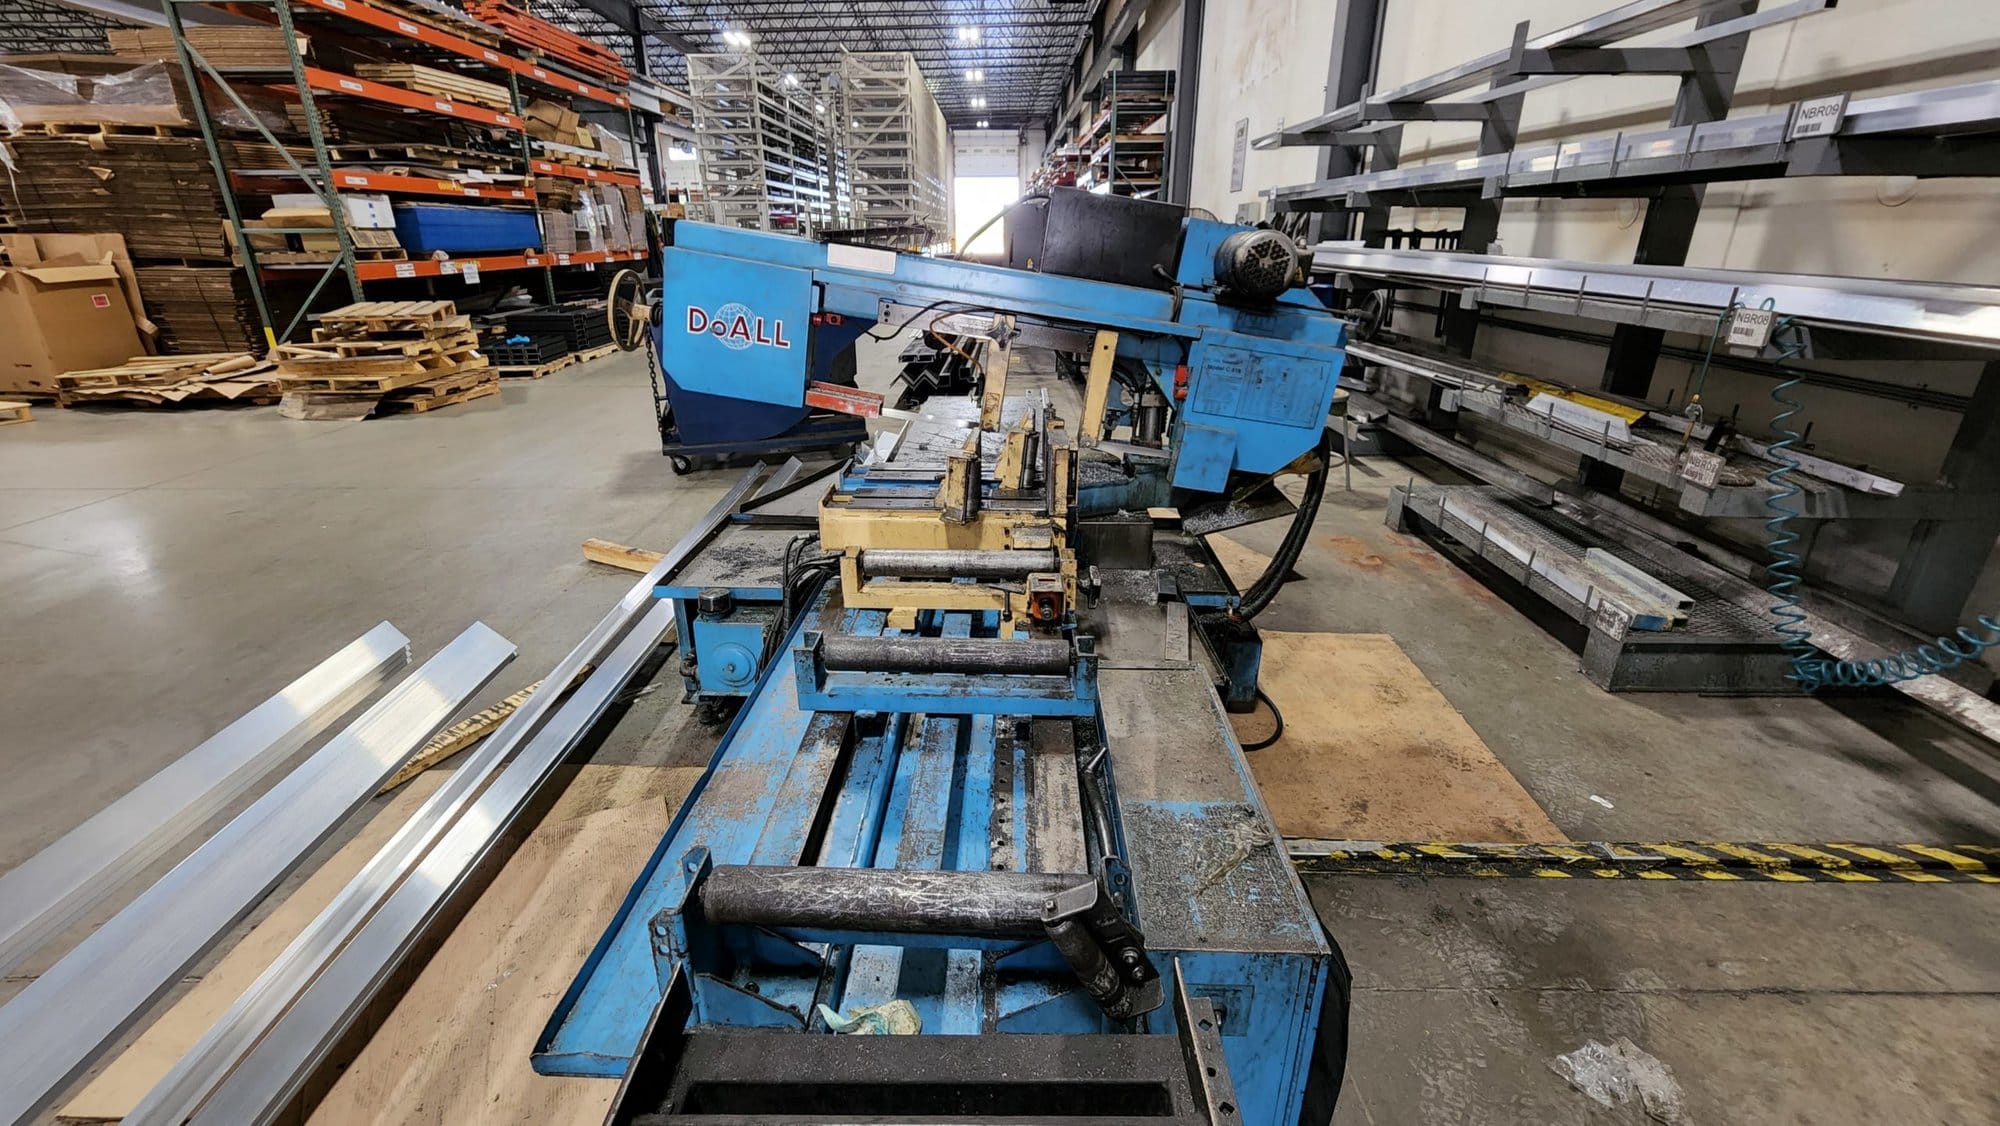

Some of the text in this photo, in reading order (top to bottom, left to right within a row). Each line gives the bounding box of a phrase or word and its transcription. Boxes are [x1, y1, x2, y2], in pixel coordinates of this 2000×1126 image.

[1800, 104, 1840, 119] NBR09
[1736, 312, 1770, 325] NBR08
[687, 305, 790, 349] DoALL
